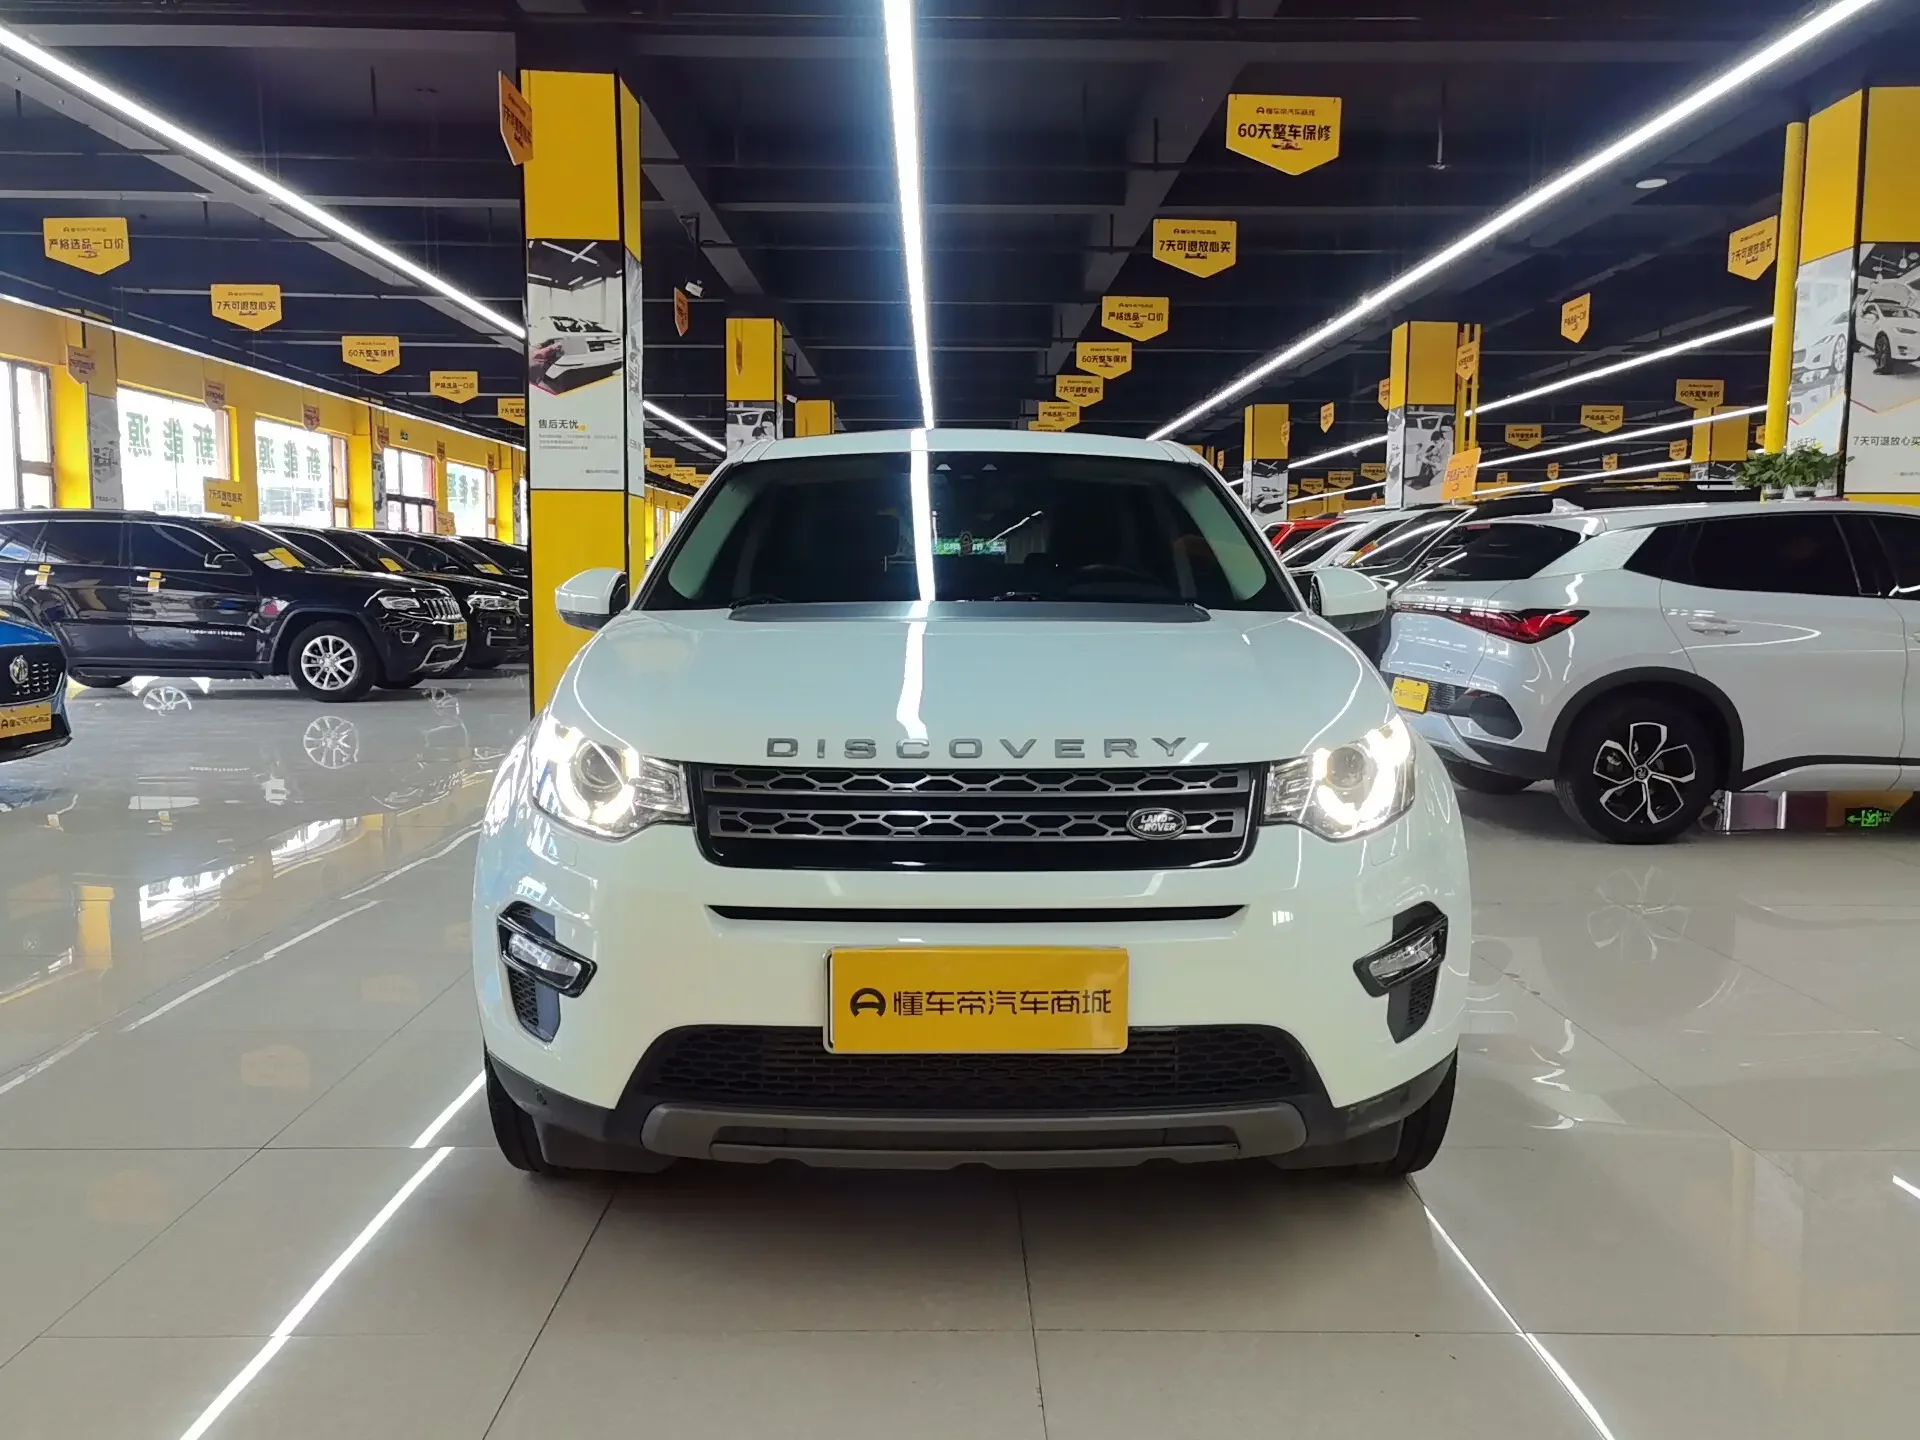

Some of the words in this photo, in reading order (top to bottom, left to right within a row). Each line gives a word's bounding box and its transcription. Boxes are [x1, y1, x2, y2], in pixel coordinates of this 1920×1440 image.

[1238, 123, 1331, 141] 60天整车保修
[49, 238, 124, 250] 严格选品一口价
[1159, 240, 1231, 253] 7天可退放心买
[217, 301, 276, 310] 7天可退放心买
[1108, 312, 1164, 321] 严格选品一口价
[538, 419, 579, 429] 售后无忧
[1853, 436, 1920, 446] 7天可退放心买
[767, 737, 1187, 759] DISCOVERY
[1140, 813, 1168, 824] LAND
[1143, 822, 1177, 832] ROVER
[893, 990, 1112, 1016] 懂车帝汽车商城
